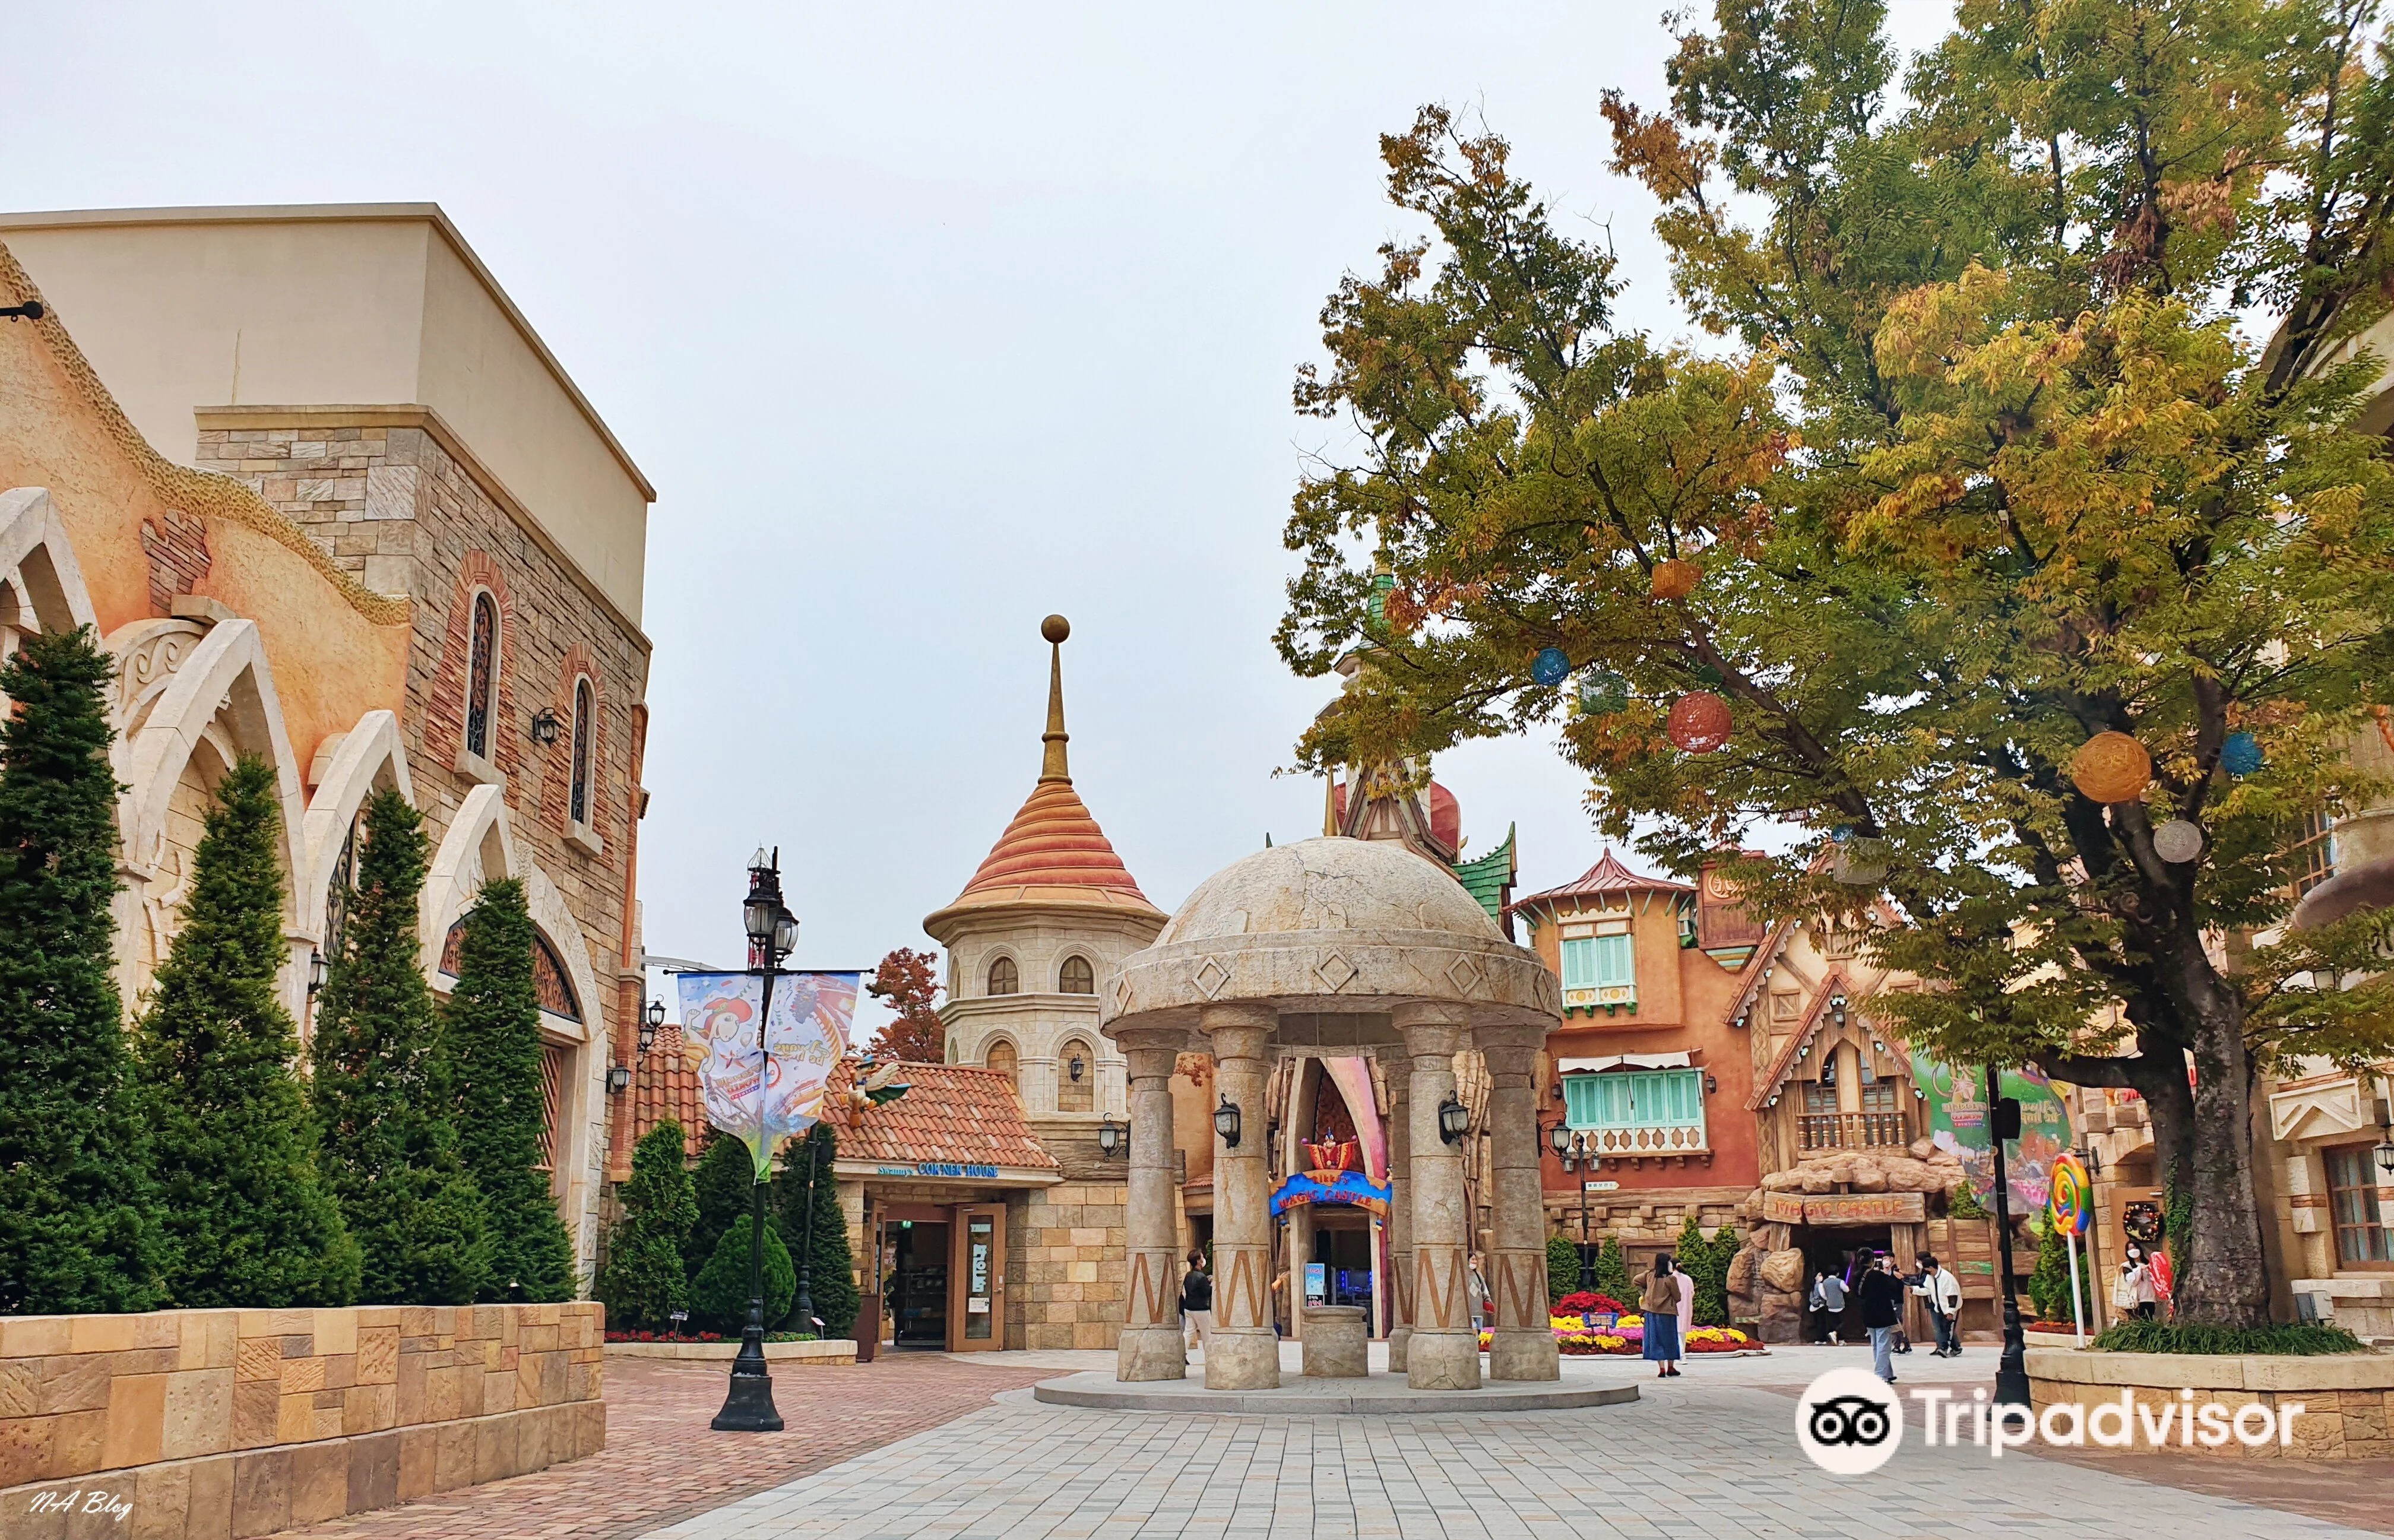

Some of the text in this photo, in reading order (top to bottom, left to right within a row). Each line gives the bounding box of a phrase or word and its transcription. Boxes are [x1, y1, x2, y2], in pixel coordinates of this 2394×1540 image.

[917, 1162, 962, 1176] CORNER
[965, 1164, 999, 1178] HOUSE
[1278, 1189, 1372, 1209] MAGIC CASTLE
[1775, 1199, 1903, 1216] MAGIC CASTLE
